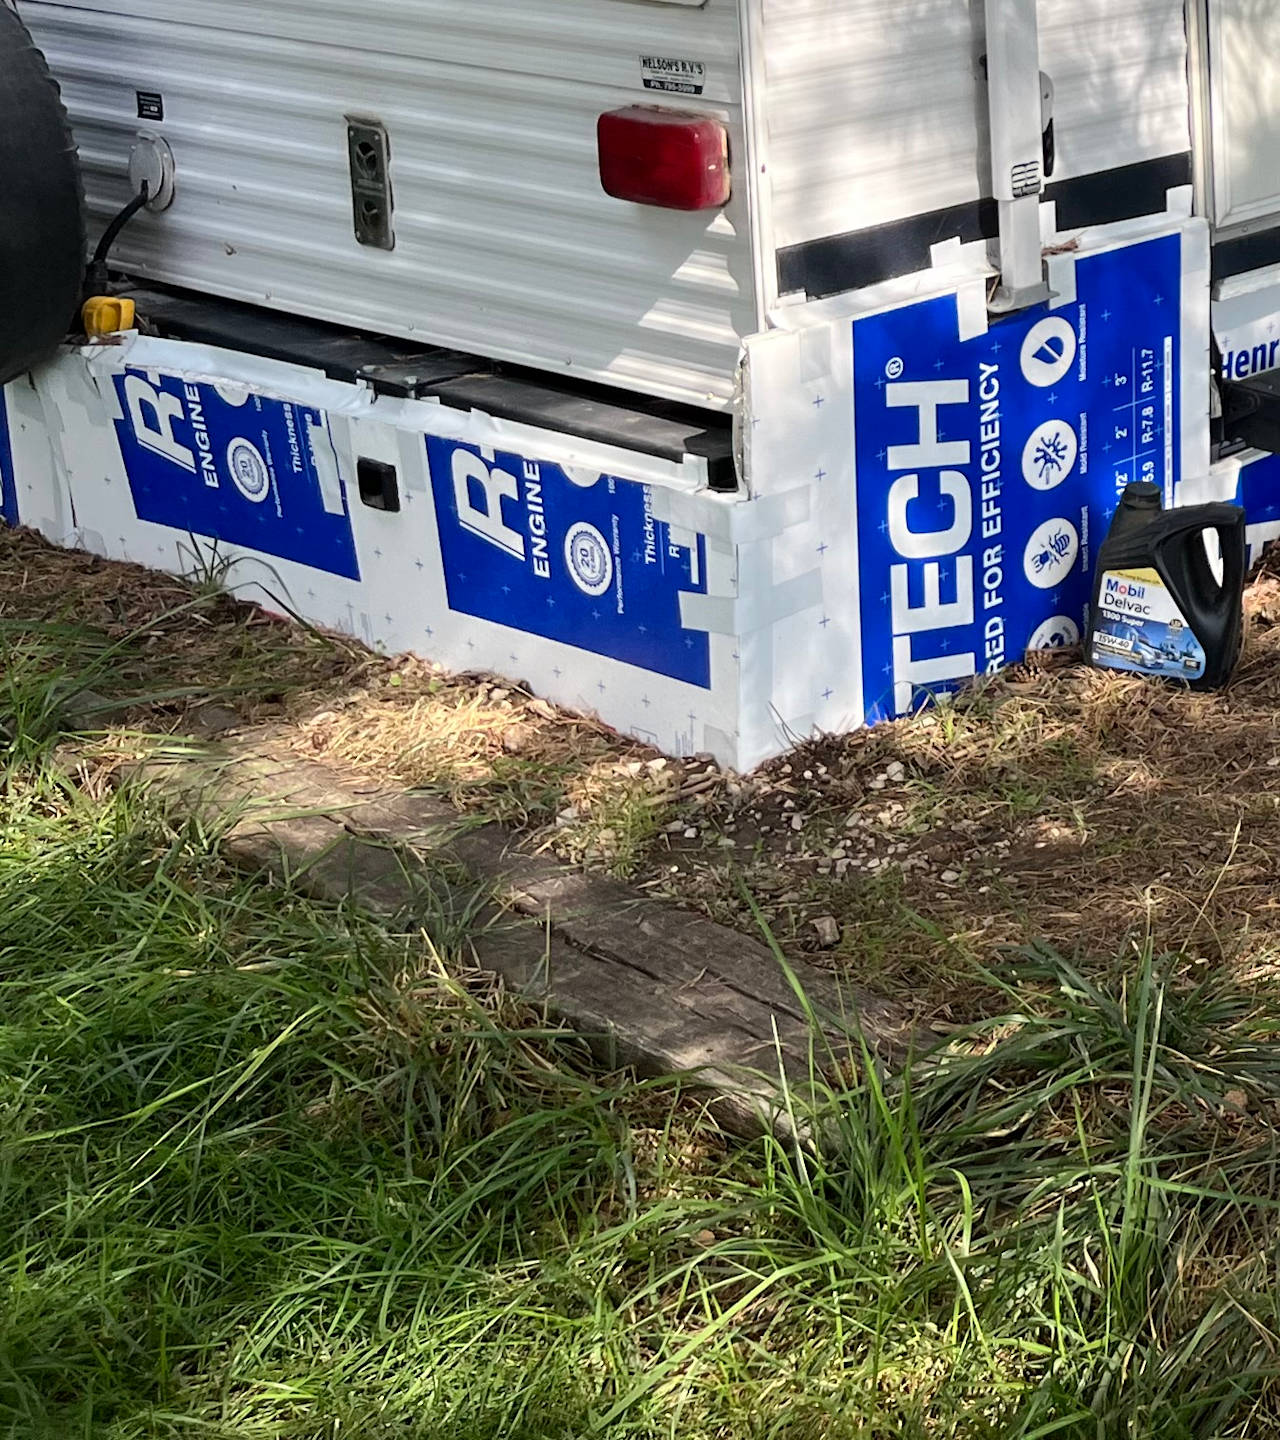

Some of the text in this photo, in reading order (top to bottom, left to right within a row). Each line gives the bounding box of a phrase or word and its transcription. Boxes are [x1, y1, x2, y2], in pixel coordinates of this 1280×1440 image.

[1141, 348, 1154, 393] R-11.7
[183, 382, 220, 489] ENGINE
[282, 403, 303, 474] Thickness
[1142, 406, 1154, 444] R-7.8
[979, 362, 1002, 539] EFFICIENCY
[606, 474, 616, 494] 100
[522, 458, 550, 579] ENGINE
[580, 547, 590, 568] 20
[611, 513, 625, 614] Performance Warranty
[885, 378, 976, 715] TECH
[983, 544, 1003, 610] FOR
[1106, 578, 1145, 599] Mobil
[1101, 609, 1121, 621] 1300
[1121, 614, 1145, 627] Super
[1104, 592, 1151, 616] Delvac
[1098, 634, 1130, 649] 15W-40
